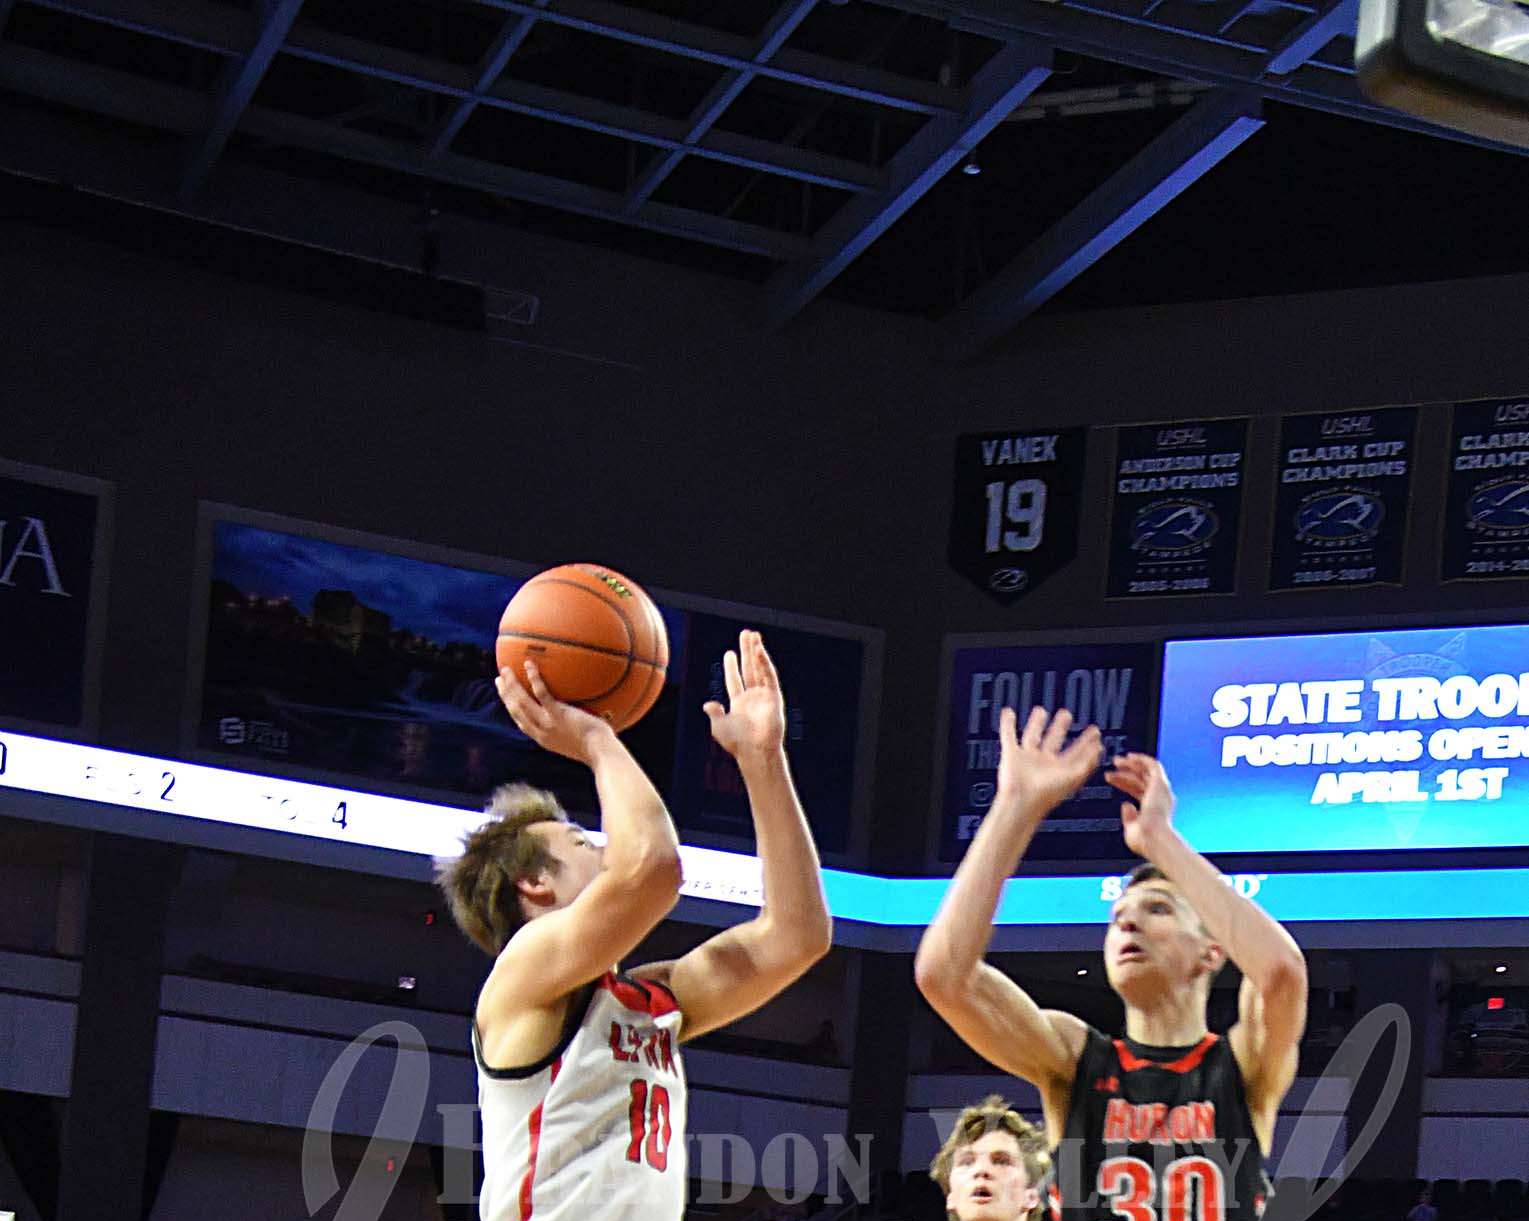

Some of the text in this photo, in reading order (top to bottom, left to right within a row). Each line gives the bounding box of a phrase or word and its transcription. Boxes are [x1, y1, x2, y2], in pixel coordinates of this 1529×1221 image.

[1156, 429, 1207, 446] USHL
[1321, 416, 1374, 435] USHL
[981, 435, 1059, 466] VANEK
[1119, 453, 1241, 475] ANDERSON CUP
[1287, 441, 1405, 464] CLARK CUP
[1118, 472, 1240, 494] CHAMPIONS
[1282, 460, 1407, 484] CHAMPIONS
[985, 479, 1048, 553] 19
[968, 668, 1133, 735] FOLLOW
[1210, 680, 1364, 728] STATE
[1221, 733, 1423, 768] POSITIONS
[160, 772, 175, 801] 2
[1309, 767, 1509, 805] APRIL 1ST
[331, 802, 348, 829] 4
[625, 1079, 672, 1173] 10
[1102, 1098, 1217, 1146] HURON
